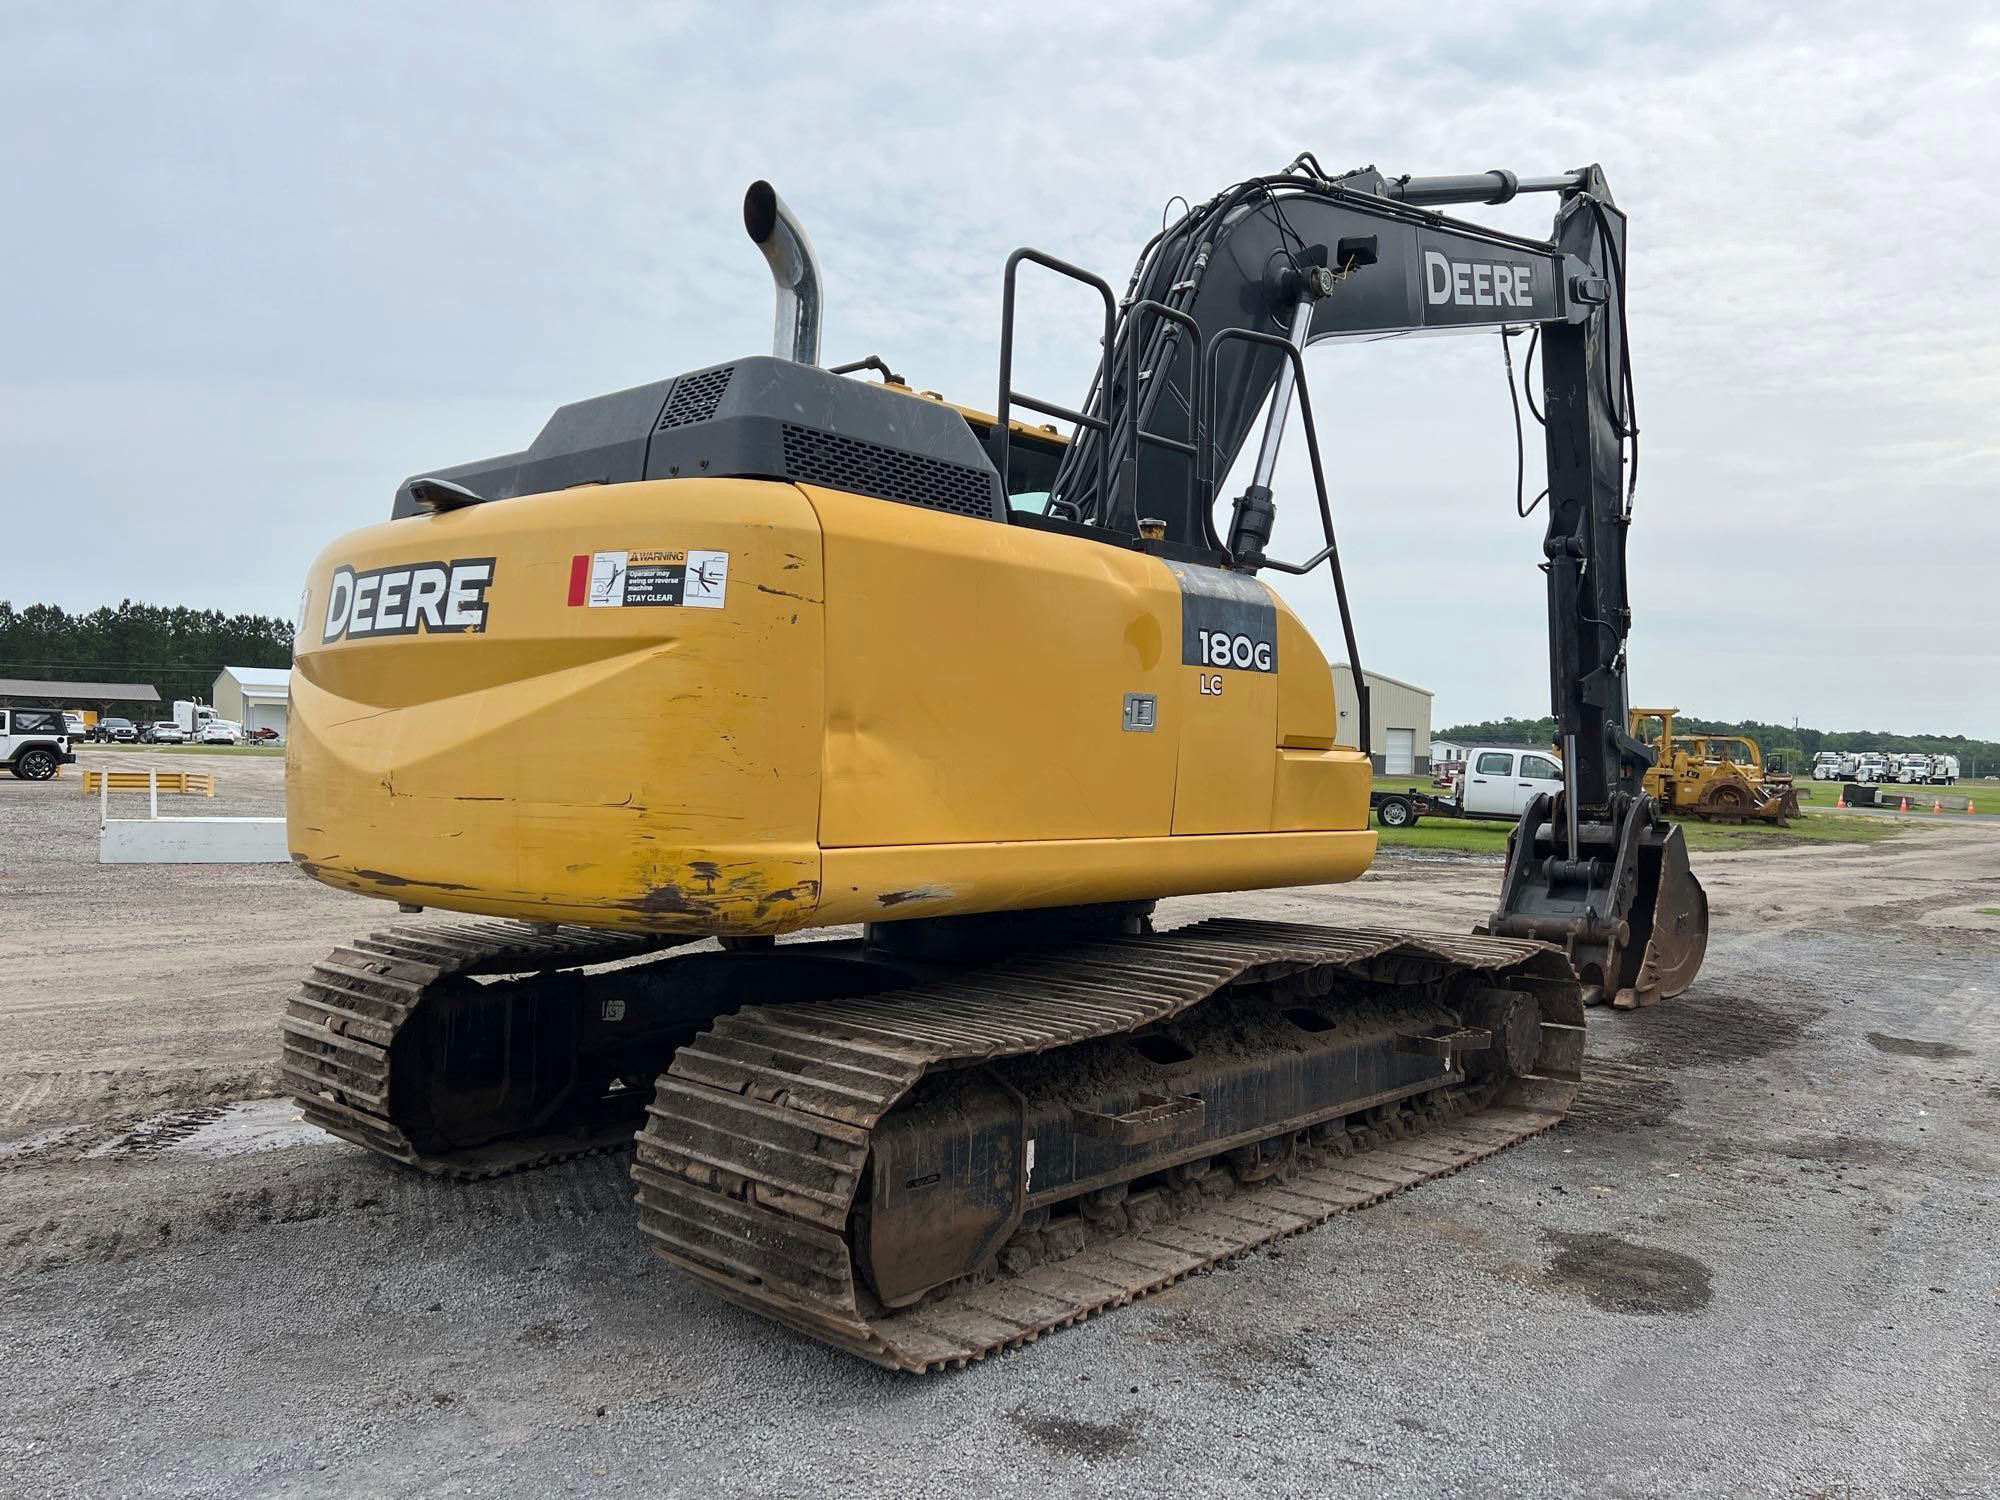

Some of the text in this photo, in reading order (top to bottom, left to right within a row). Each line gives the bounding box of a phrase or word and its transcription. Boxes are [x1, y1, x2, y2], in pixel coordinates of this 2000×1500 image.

[1424, 250, 1533, 307] DEERE
[639, 551, 685, 561] WARNING
[629, 570, 656, 578] Operator
[324, 562, 491, 639] DEERE
[626, 594, 673, 602] STAY CLEAR
[1199, 630, 1271, 671] 180G
[1200, 674, 1222, 695] LC
